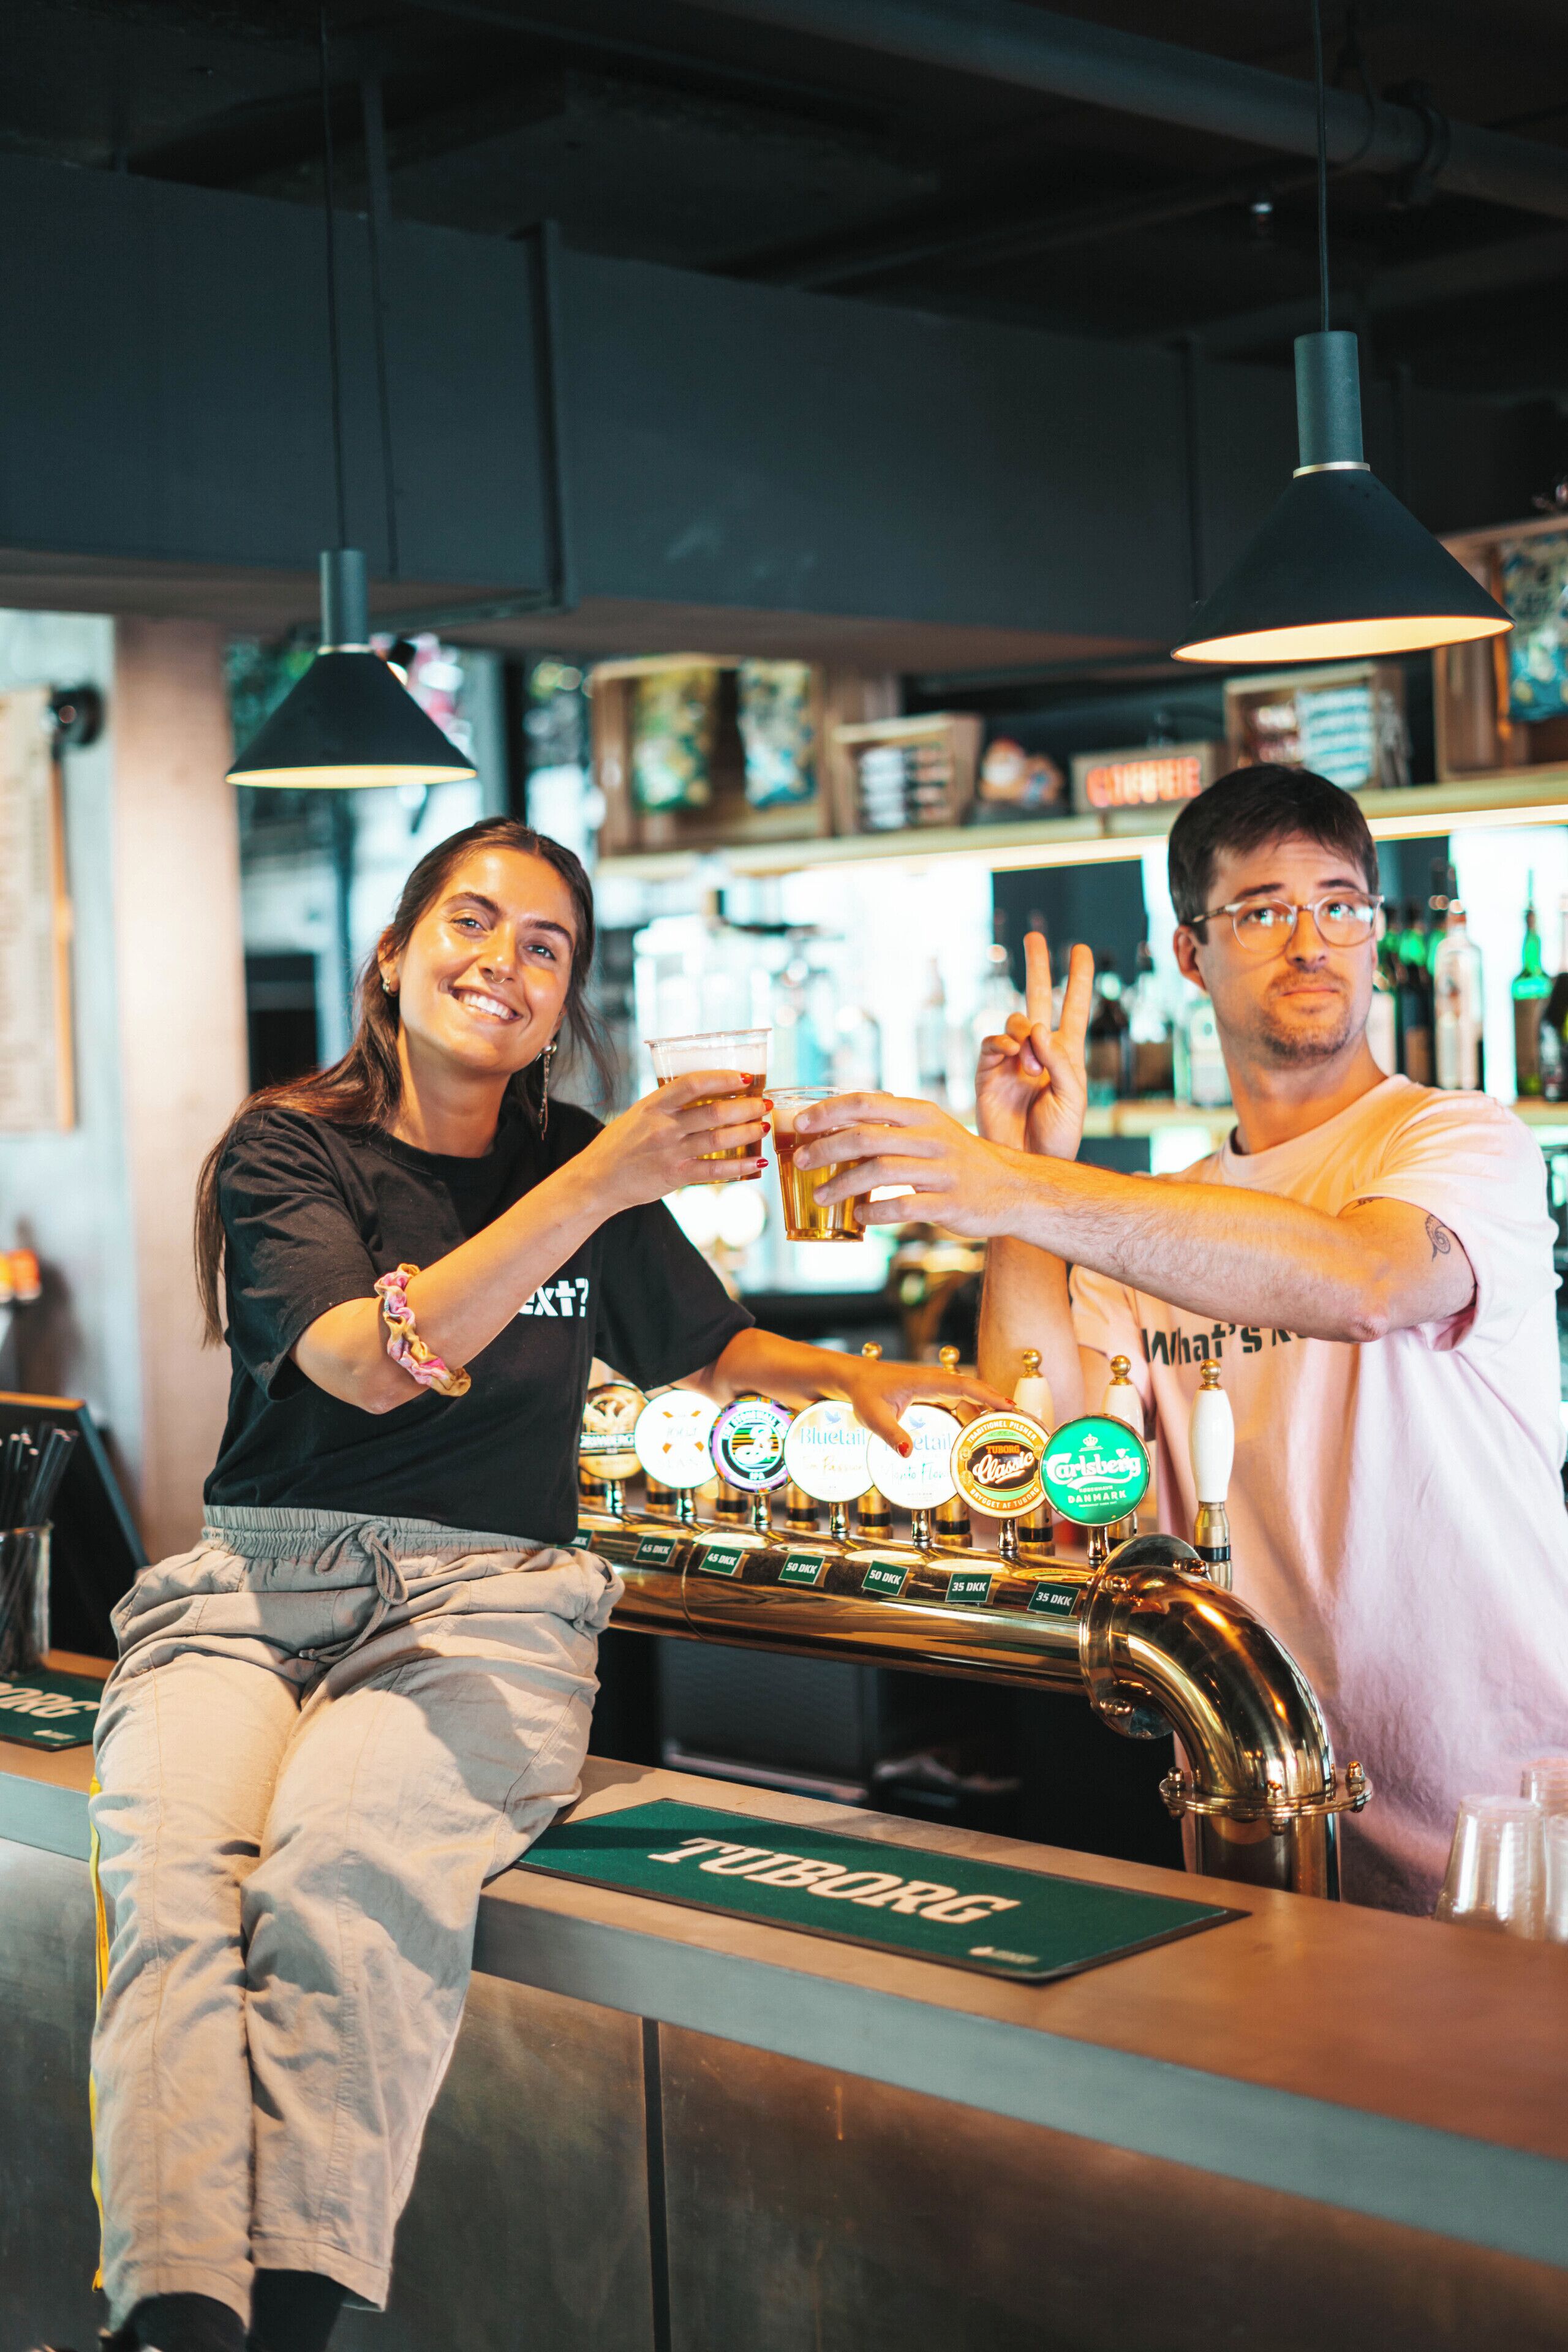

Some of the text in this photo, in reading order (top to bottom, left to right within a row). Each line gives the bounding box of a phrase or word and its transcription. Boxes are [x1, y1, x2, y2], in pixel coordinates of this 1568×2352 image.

[801, 1427, 865, 1446] Bluetail
[967, 1420, 1038, 1443] TRADITIONEL PILSNER
[986, 1445, 1020, 1455] TUBORG
[972, 1451, 1035, 1484] Classic
[1046, 1452, 1141, 1485] Carlsberg
[749, 1472, 766, 1480] IPA
[970, 1488, 1000, 1509] BRYGGET
[1013, 1487, 1040, 1505] TUBORG
[1067, 1490, 1128, 1504] DANMARK
[641, 1544, 671, 1555] 45 DKK
[707, 1553, 737, 1566] 45 DKK
[786, 1562, 818, 1574] 50 DKK
[869, 1569, 902, 1585] 50 DKK
[952, 1582, 987, 1591] 35 DKK
[1036, 1591, 1072, 1607] 35 DKK
[647, 1837, 1022, 1924] TUBORG
